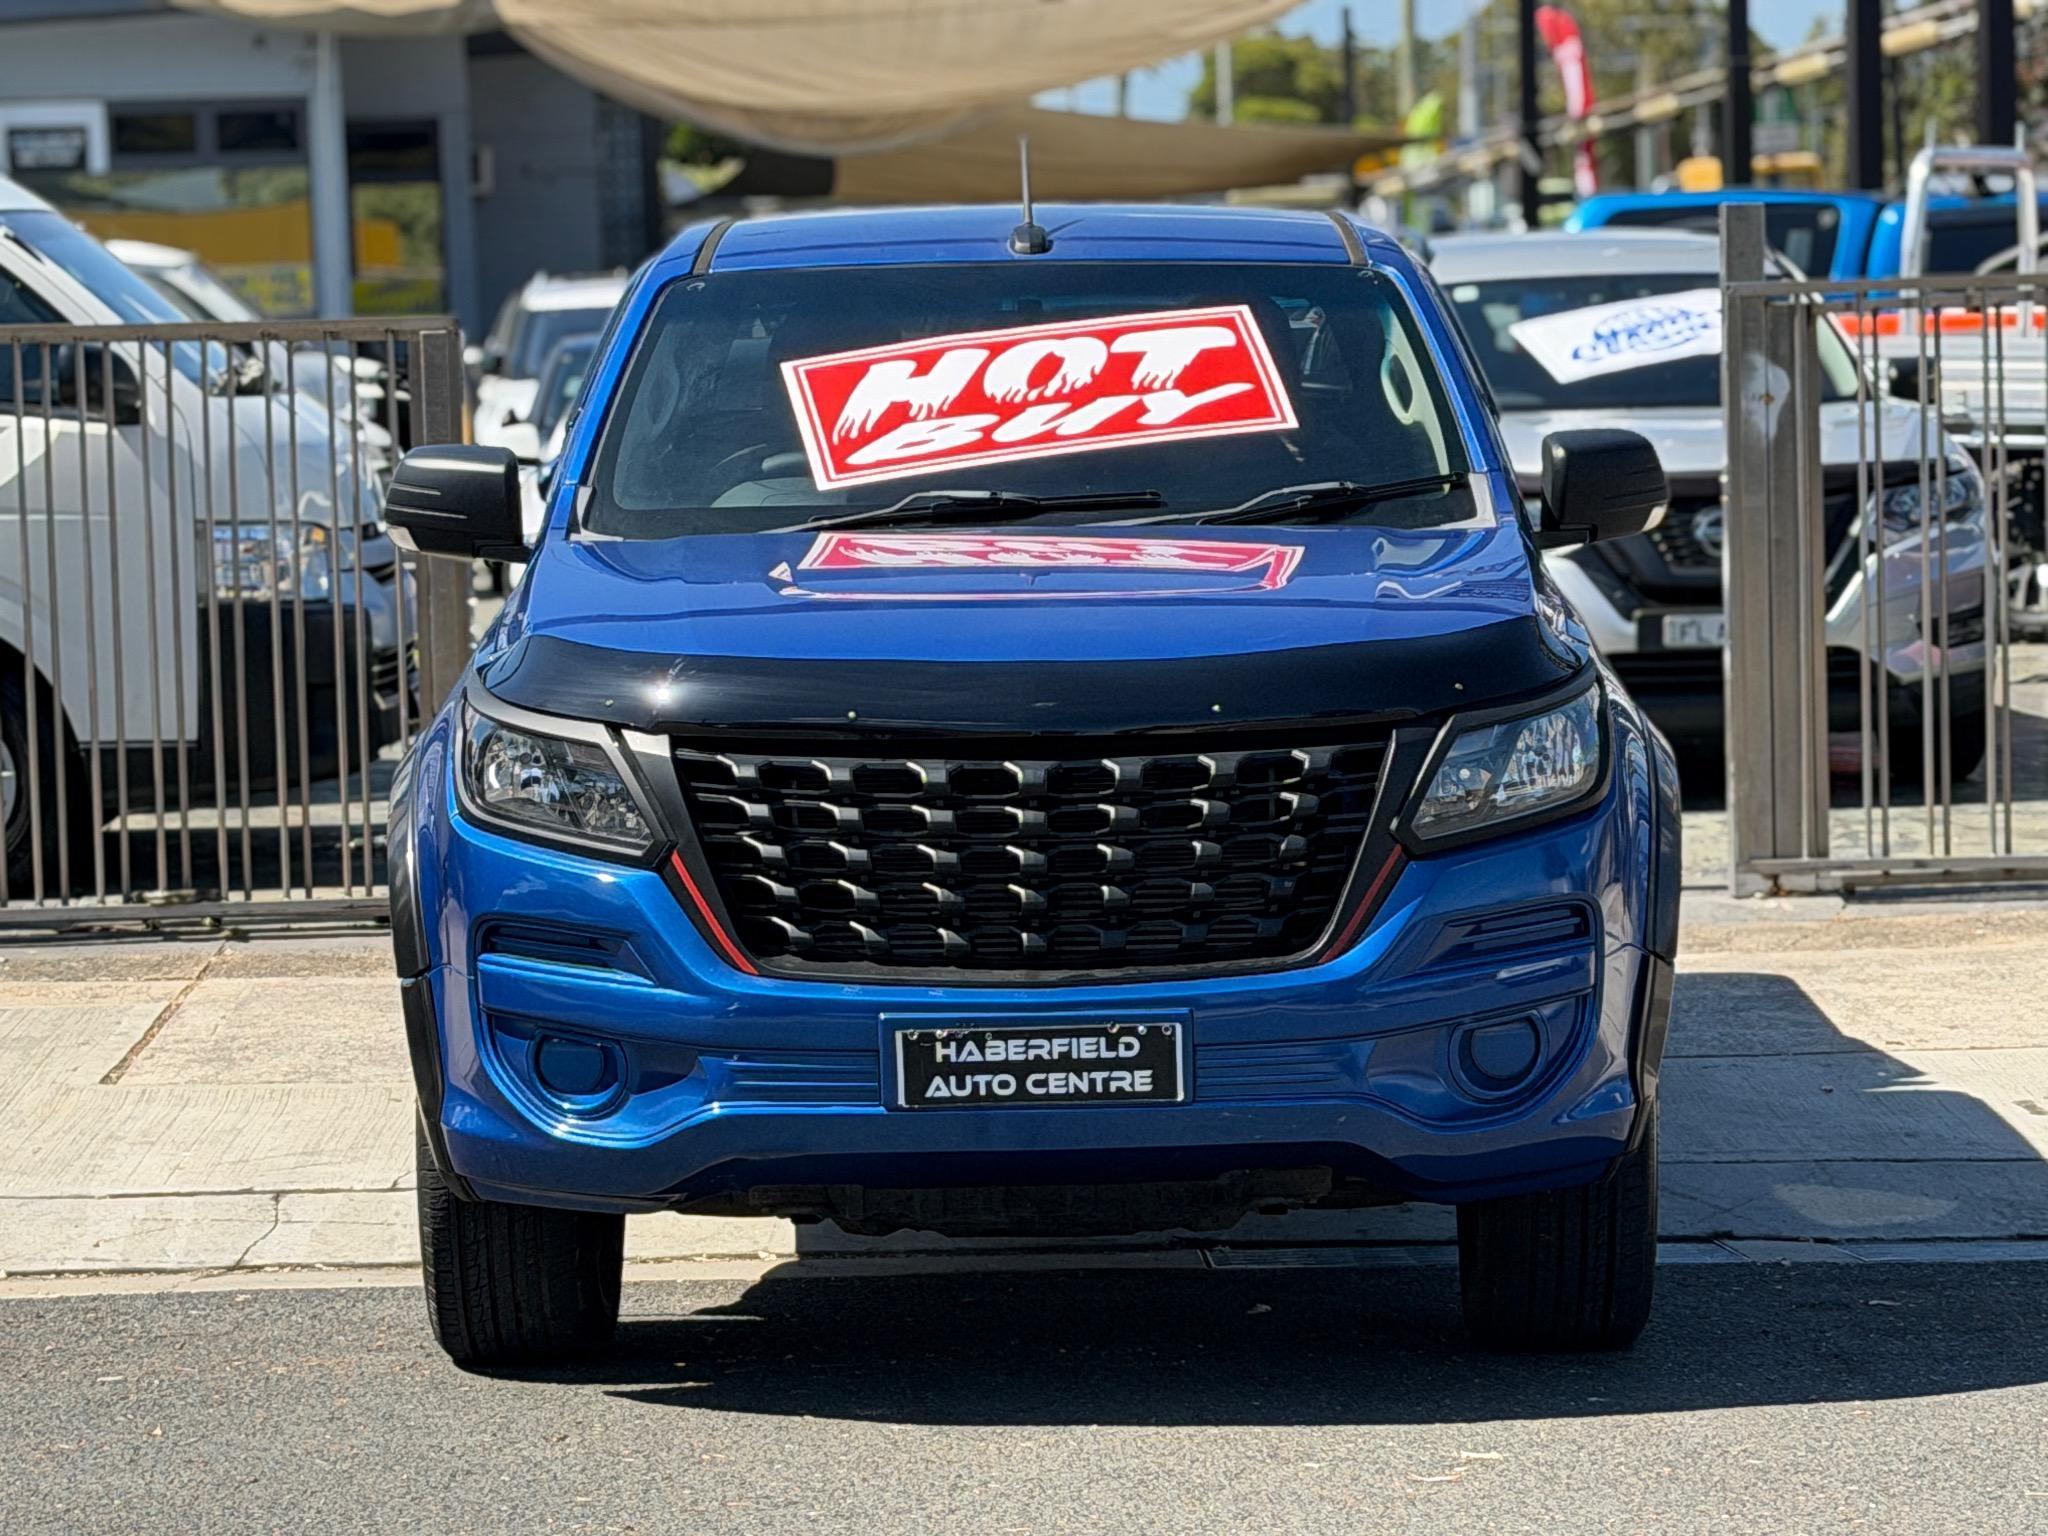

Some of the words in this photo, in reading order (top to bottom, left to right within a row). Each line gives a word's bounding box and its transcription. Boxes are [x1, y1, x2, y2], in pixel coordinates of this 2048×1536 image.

[832, 326, 1237, 445] HOT
[844, 382, 1255, 465] BUY
[935, 1036, 1141, 1063] HABERFIELD
[924, 1074, 1017, 1098] AUTO
[1025, 1069, 1154, 1095] CENTRE
